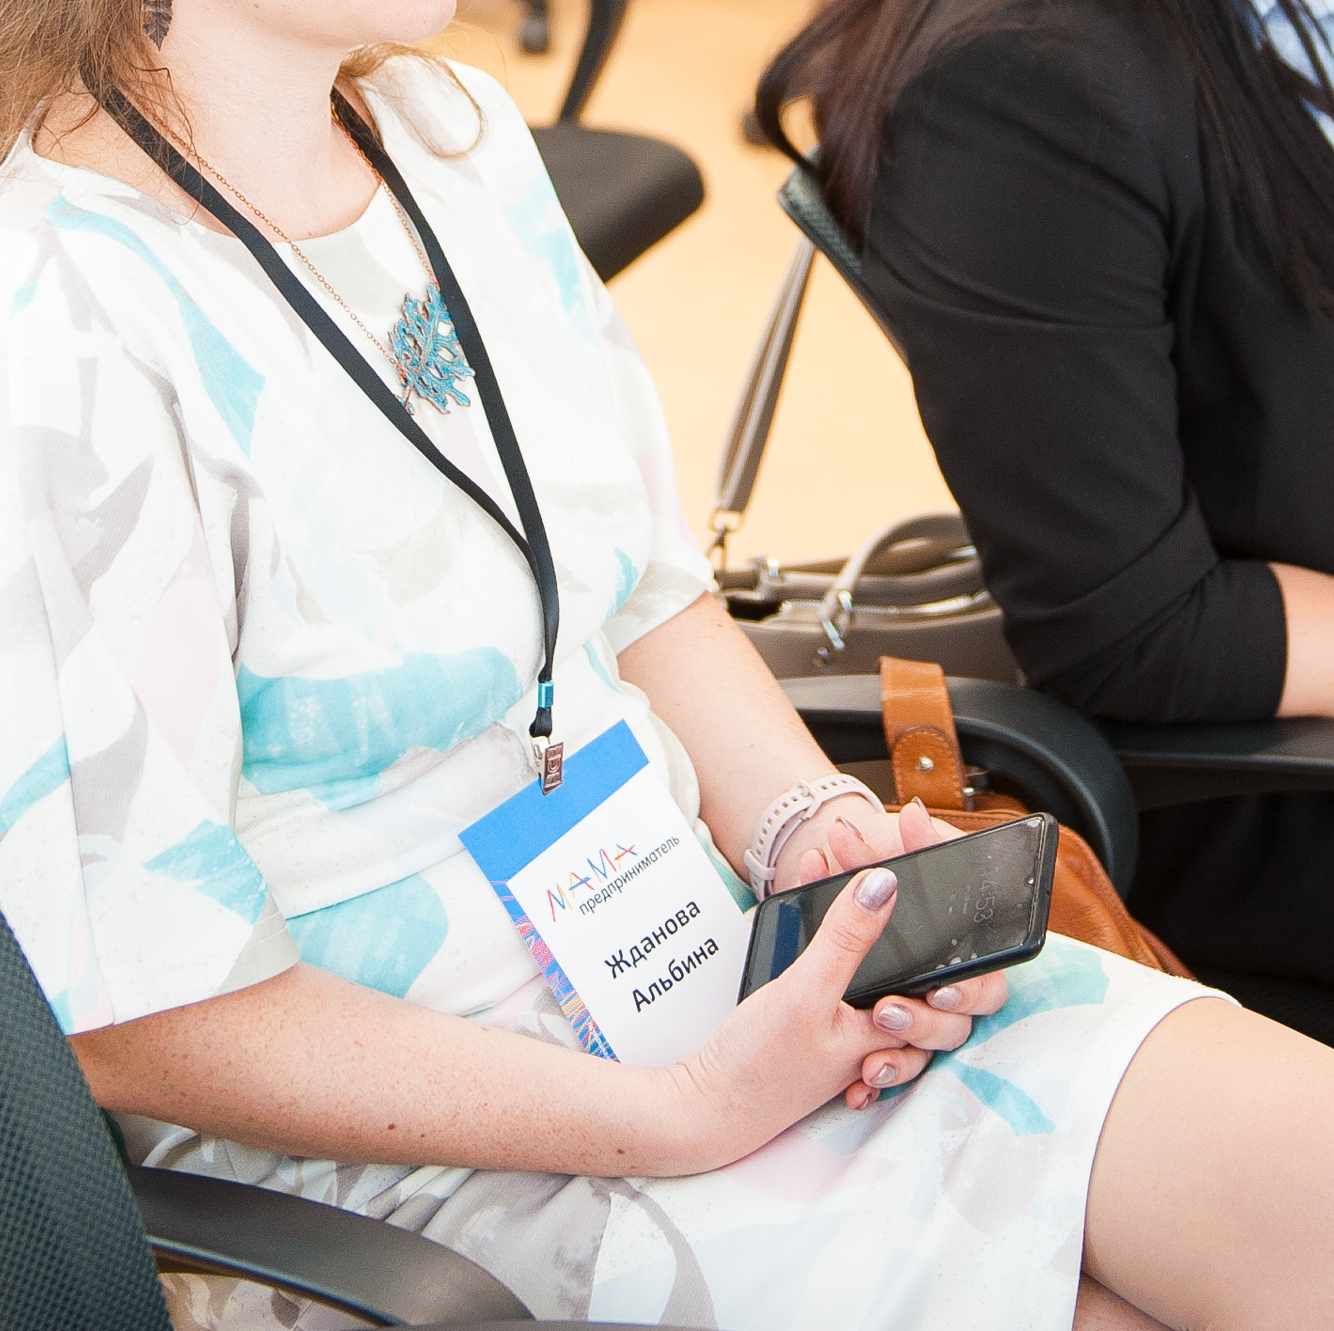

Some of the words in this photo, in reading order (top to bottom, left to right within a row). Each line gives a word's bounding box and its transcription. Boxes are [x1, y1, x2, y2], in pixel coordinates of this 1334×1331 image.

[579, 835, 681, 916] предприниматель
[973, 866, 999, 923] 14:53
[604, 899, 701, 980] Жданова
[631, 934, 720, 1013] Альбина
